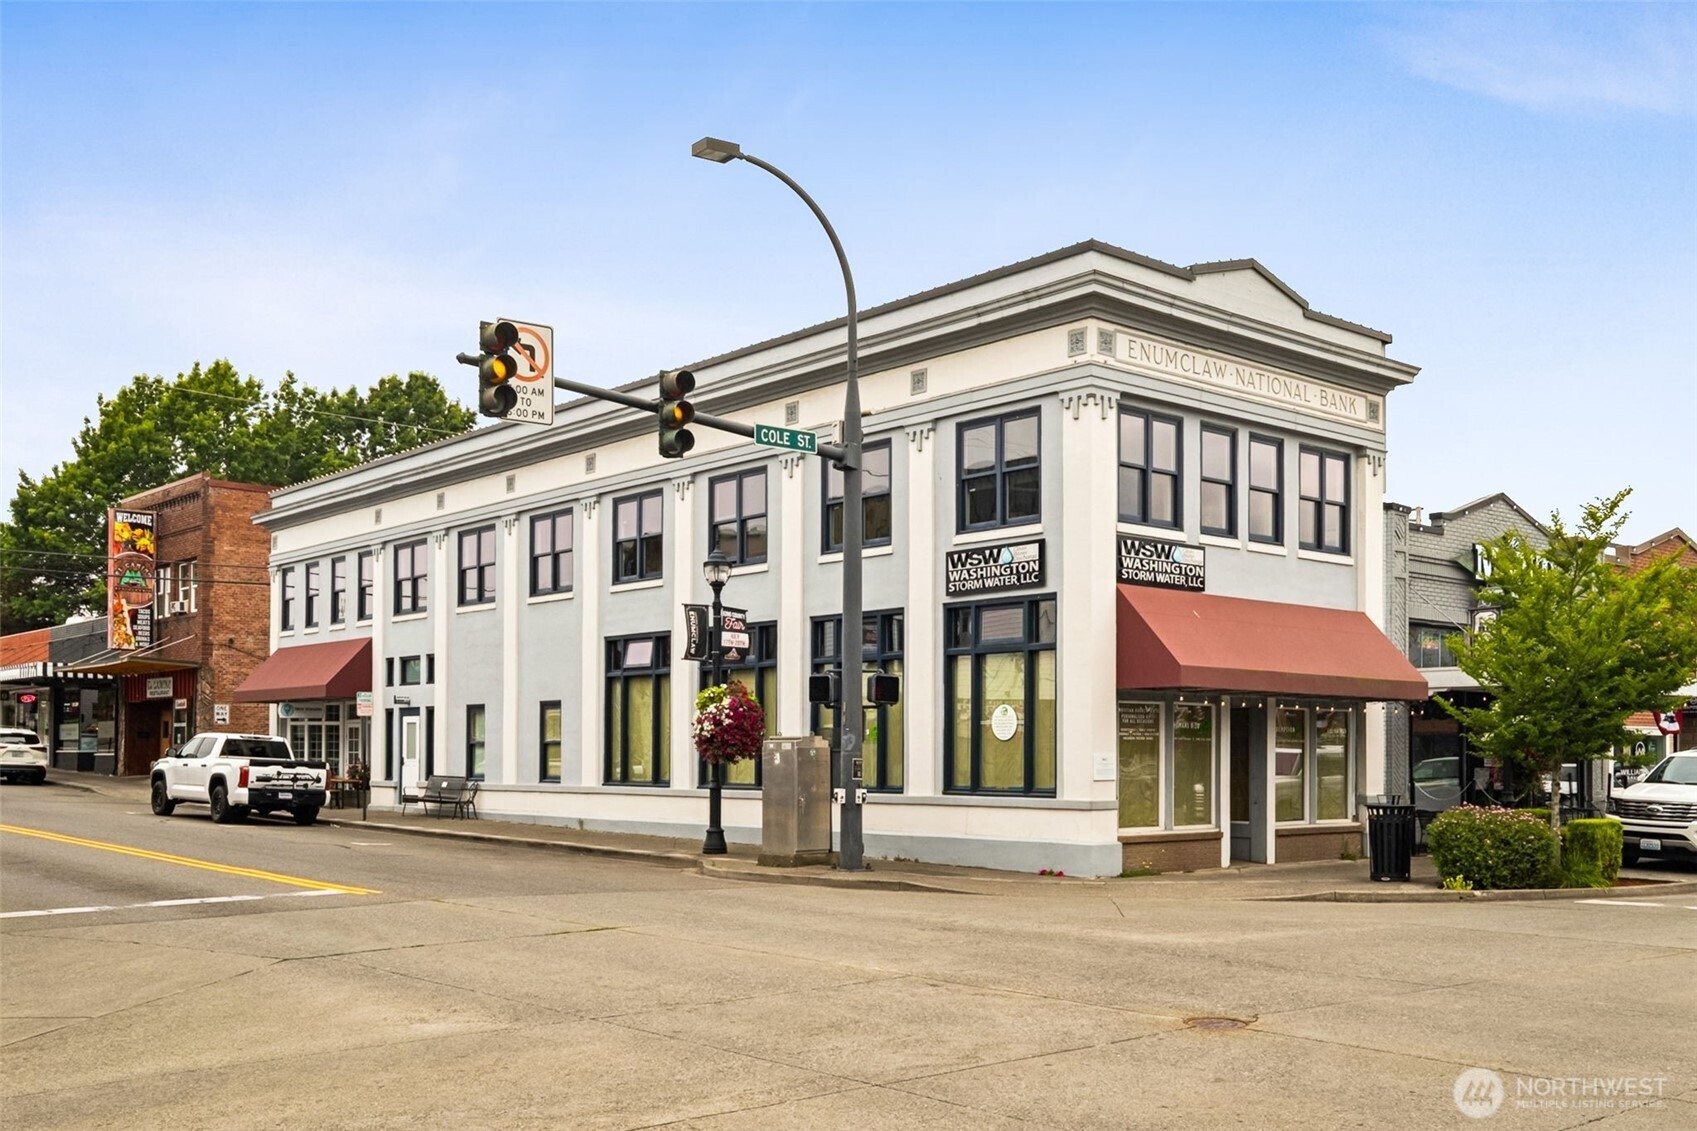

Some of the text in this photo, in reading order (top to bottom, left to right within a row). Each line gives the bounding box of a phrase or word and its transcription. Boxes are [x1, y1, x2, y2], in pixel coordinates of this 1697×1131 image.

[1128, 339, 1358, 416] ENUMCLAW NATIONAL BANK
[520, 397, 532, 407] TO
[531, 387, 545, 397] AM
[531, 410, 545, 420] PM
[761, 428, 812, 449] COLE ST.
[116, 511, 153, 526] WELCOME
[949, 548, 1001, 570] WSW
[1121, 540, 1174, 561] WSW
[948, 560, 1039, 582] WASHINGTON
[1121, 556, 1204, 577] WASHINGTON
[948, 572, 1039, 592] STORM WATER, LLC
[1121, 568, 1204, 588] STORM WATER, LLC
[689, 610, 697, 655] ENUMCLAW
[724, 616, 746, 631] Fair
